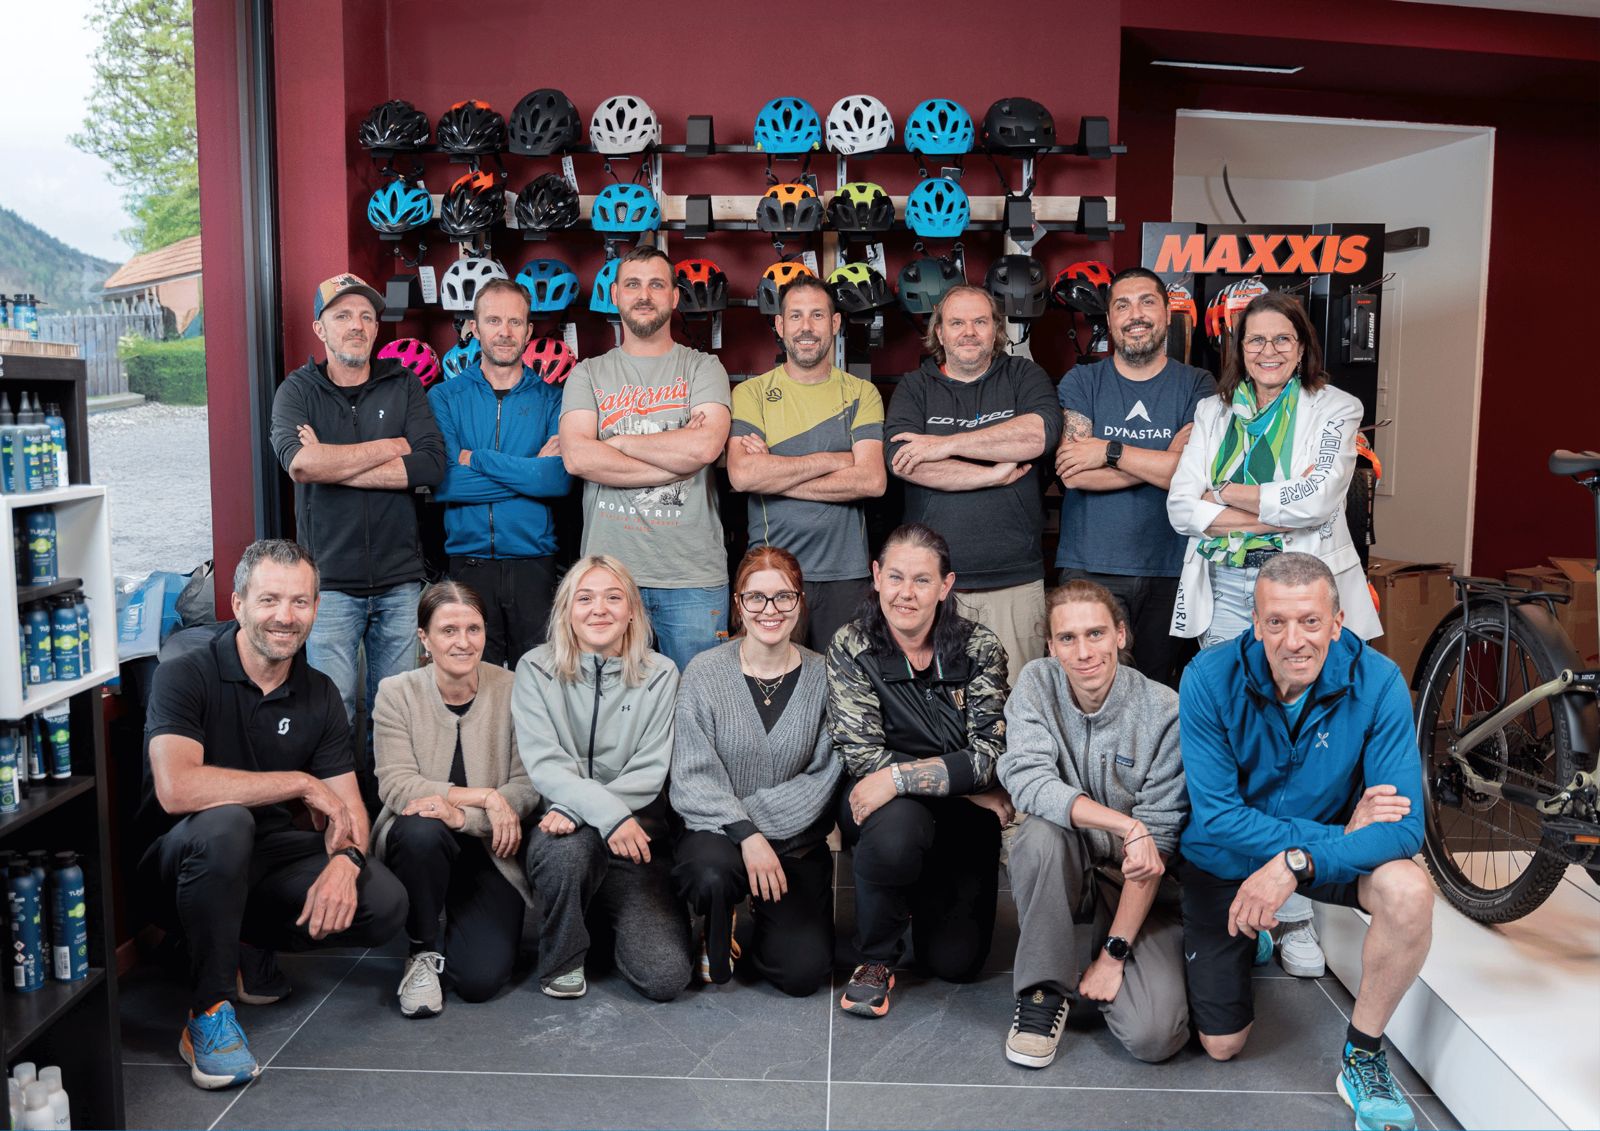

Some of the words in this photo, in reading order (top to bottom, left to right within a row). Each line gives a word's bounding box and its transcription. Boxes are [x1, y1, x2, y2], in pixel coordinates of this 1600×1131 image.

[1154, 234, 1370, 274] MAXXIS
[594, 377, 689, 412] California
[1104, 426, 1172, 440] DYNASTAR
[599, 501, 636, 514] ROAD
[643, 509, 682, 518] TRIP
